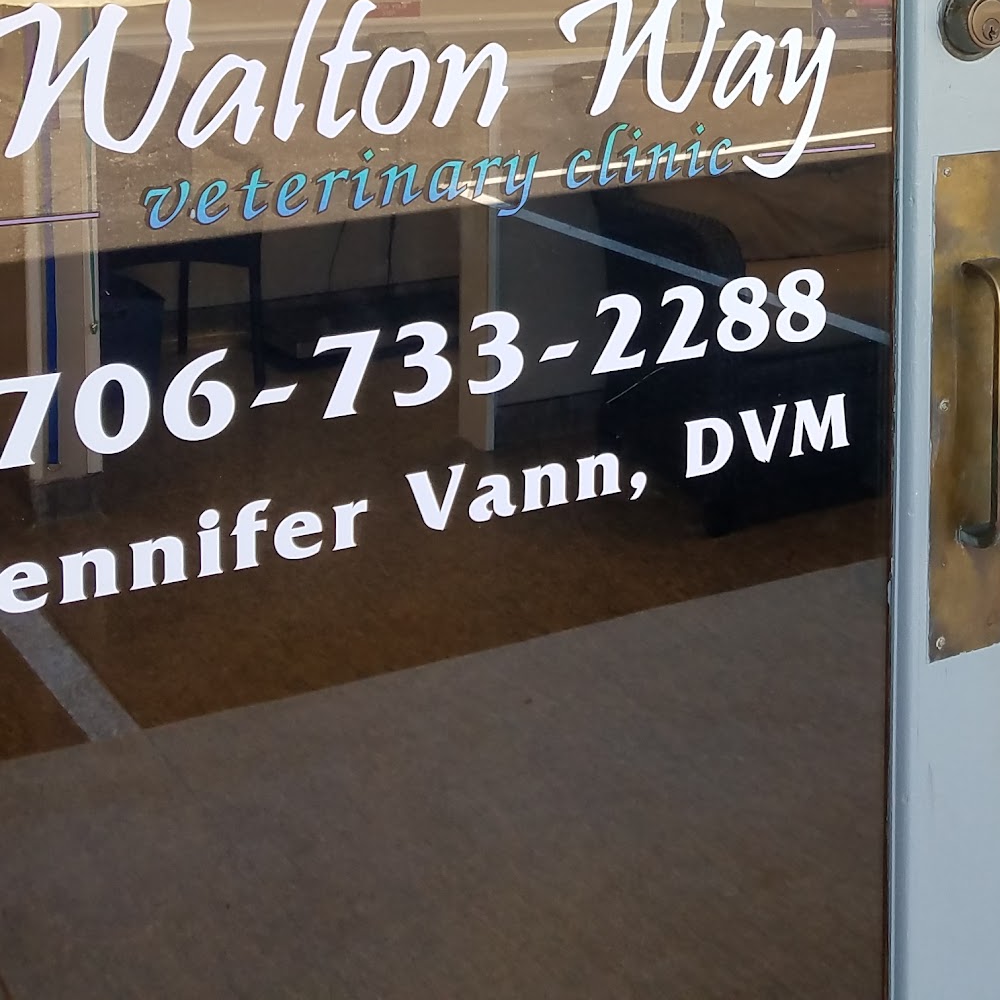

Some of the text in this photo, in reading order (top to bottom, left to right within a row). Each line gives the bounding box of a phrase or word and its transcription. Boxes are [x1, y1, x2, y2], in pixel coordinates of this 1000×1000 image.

[144, 123, 734, 230] veterinary clinic
[0, 268, 828, 471] 706-733-2288
[405, 451, 648, 532] Vann,
[684, 393, 851, 479] DVM
